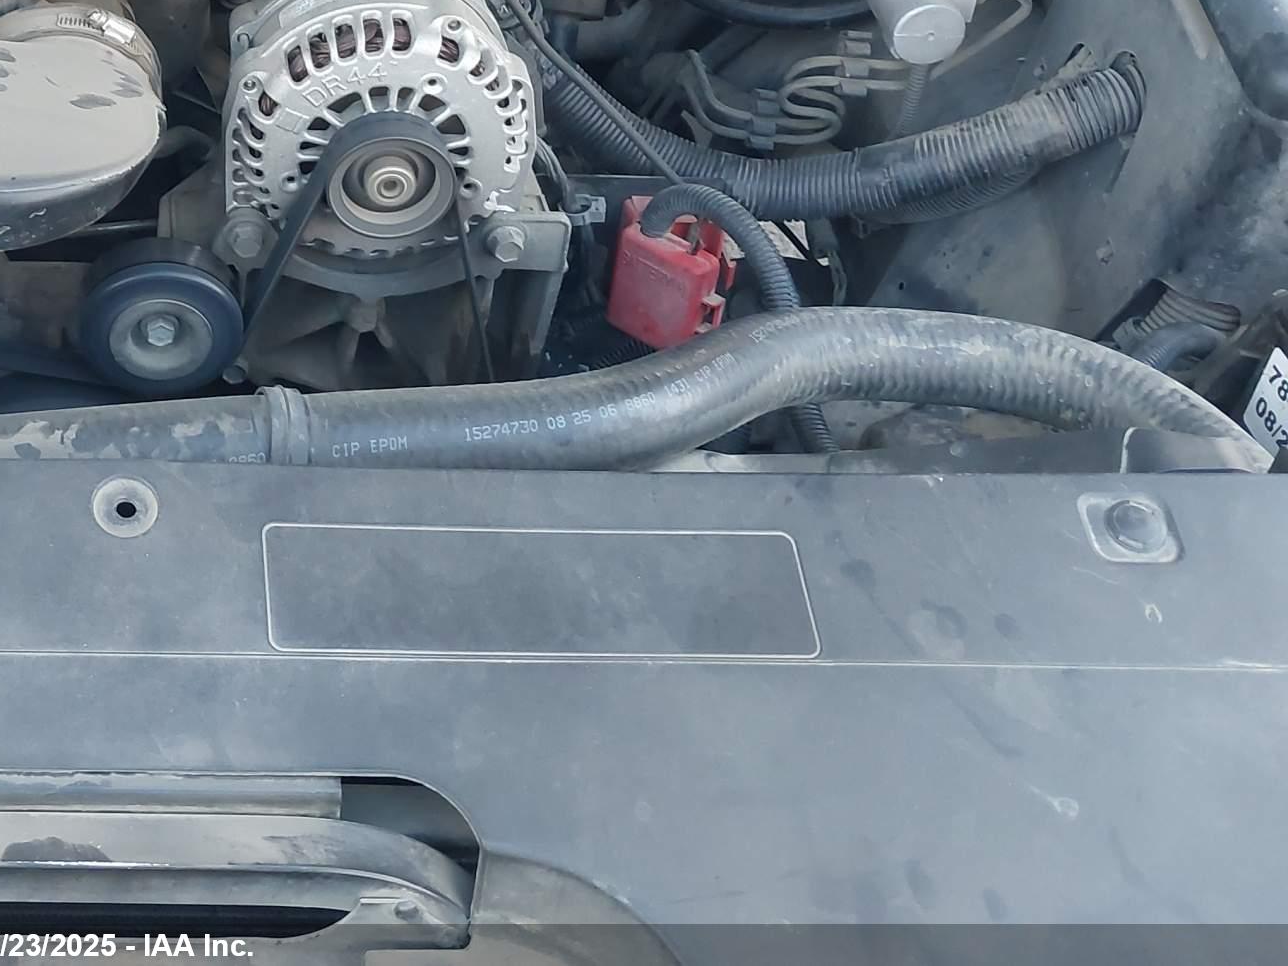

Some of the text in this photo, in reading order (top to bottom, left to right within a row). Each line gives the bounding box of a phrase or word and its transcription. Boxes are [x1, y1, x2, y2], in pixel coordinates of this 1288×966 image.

[302, 62, 388, 108] DR44
[332, 442, 360, 457] CIP
[369, 436, 408, 453] EPDM
[465, 419, 538, 442] 15274730
[546, 416, 566, 430] 08
[572, 410, 591, 425] 25
[599, 404, 617, 418] 06
[625, 391, 656, 413] 8860
[693, 365, 712, 382] CIP
[1255, 397, 1288, 448] 08/2
